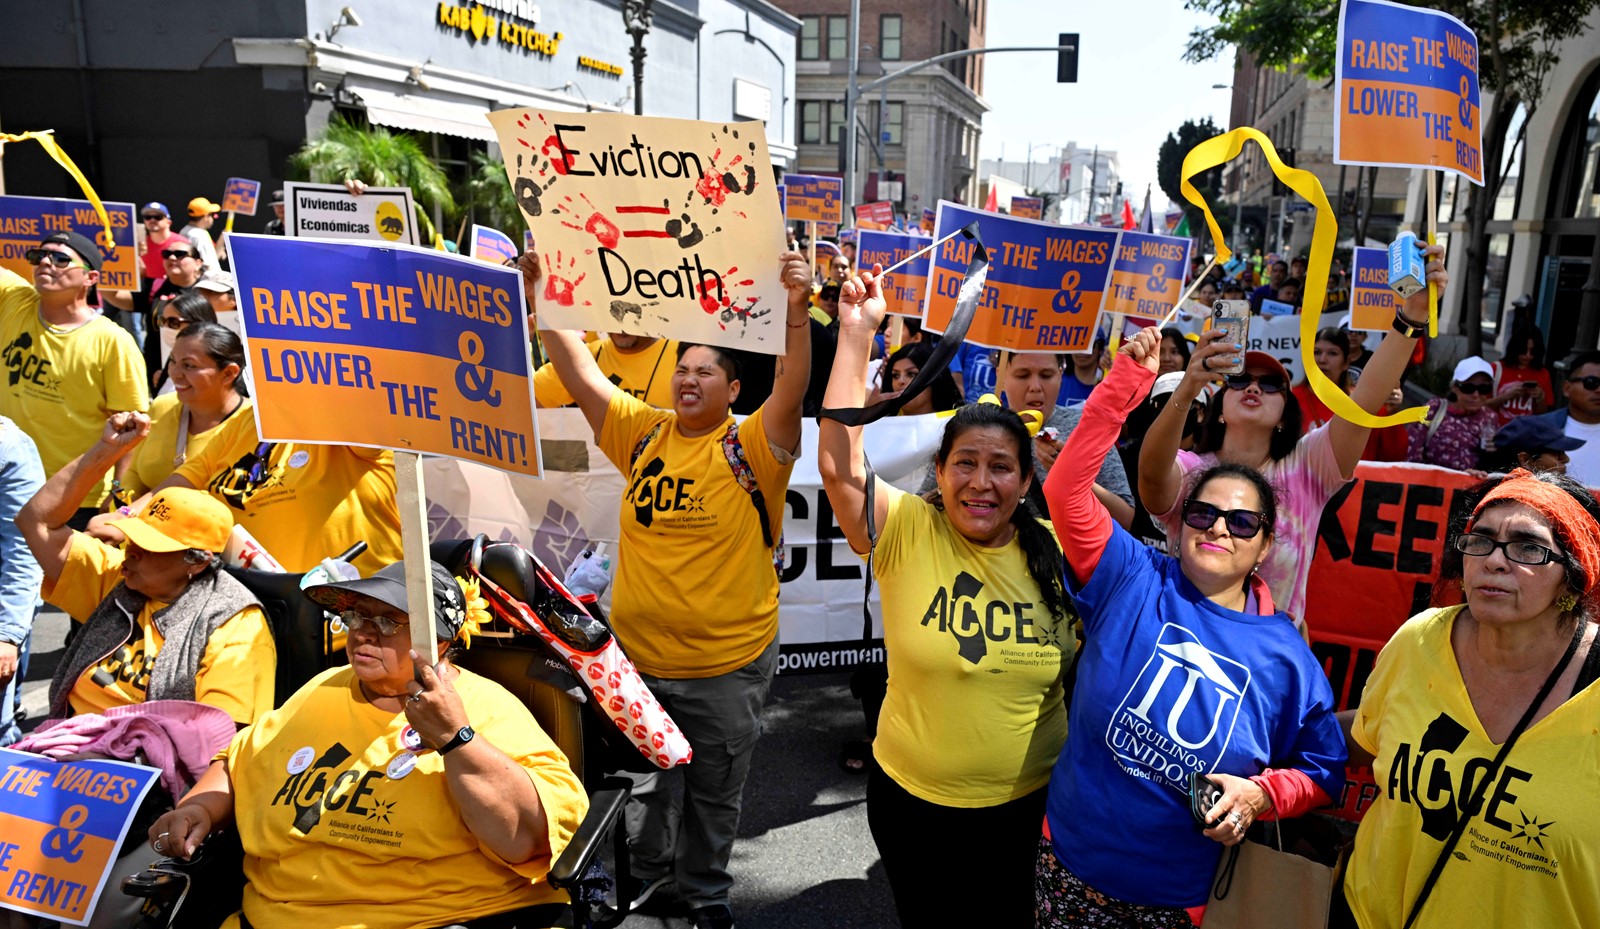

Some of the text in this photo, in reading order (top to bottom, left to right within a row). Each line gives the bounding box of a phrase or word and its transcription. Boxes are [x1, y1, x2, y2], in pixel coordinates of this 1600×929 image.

[1351, 31, 1477, 74] RAISE THE WAGES
[1458, 75, 1473, 131] &
[1348, 87, 1479, 175] LOWER THE RENT!
[554, 124, 705, 180] Eviction
[300, 197, 357, 212] Viviendas
[41, 213, 74, 232] THE
[301, 218, 370, 234] Económicas
[862, 249, 892, 267] RAISE
[1002, 241, 1041, 271] THE
[1045, 237, 1109, 265] WAGES
[1141, 241, 1184, 262] WAGES
[598, 247, 723, 302] Death
[1146, 263, 1168, 294] &
[252, 270, 513, 330] RAISE THE WAGES
[895, 286, 917, 302] THE
[1051, 270, 1083, 314] &
[1114, 284, 1137, 301] THE
[1357, 292, 1393, 308] LOWER
[1001, 303, 1038, 330] THE
[1036, 325, 1088, 346] RENT!
[455, 330, 501, 408] &
[261, 347, 528, 467] LOWER THE RENT!
[920, 585, 1040, 645] ACCE
[1000, 649, 1026, 657] Alliance
[1004, 657, 1039, 667] Community
[1127, 652, 1235, 750] IU
[1119, 711, 1207, 772] INQUILINOS
[0, 764, 138, 805] THE WAGES
[1152, 772, 1163, 784] in
[40, 804, 89, 864] &
[328, 820, 404, 839] Alliance of Californians for
[329, 829, 402, 849] Community Empowerment
[1490, 839, 1499, 847] of
[1500, 840, 1549, 864] Californians
[1505, 854, 1558, 879] Empowerment
[7, 869, 88, 913] RENT!
